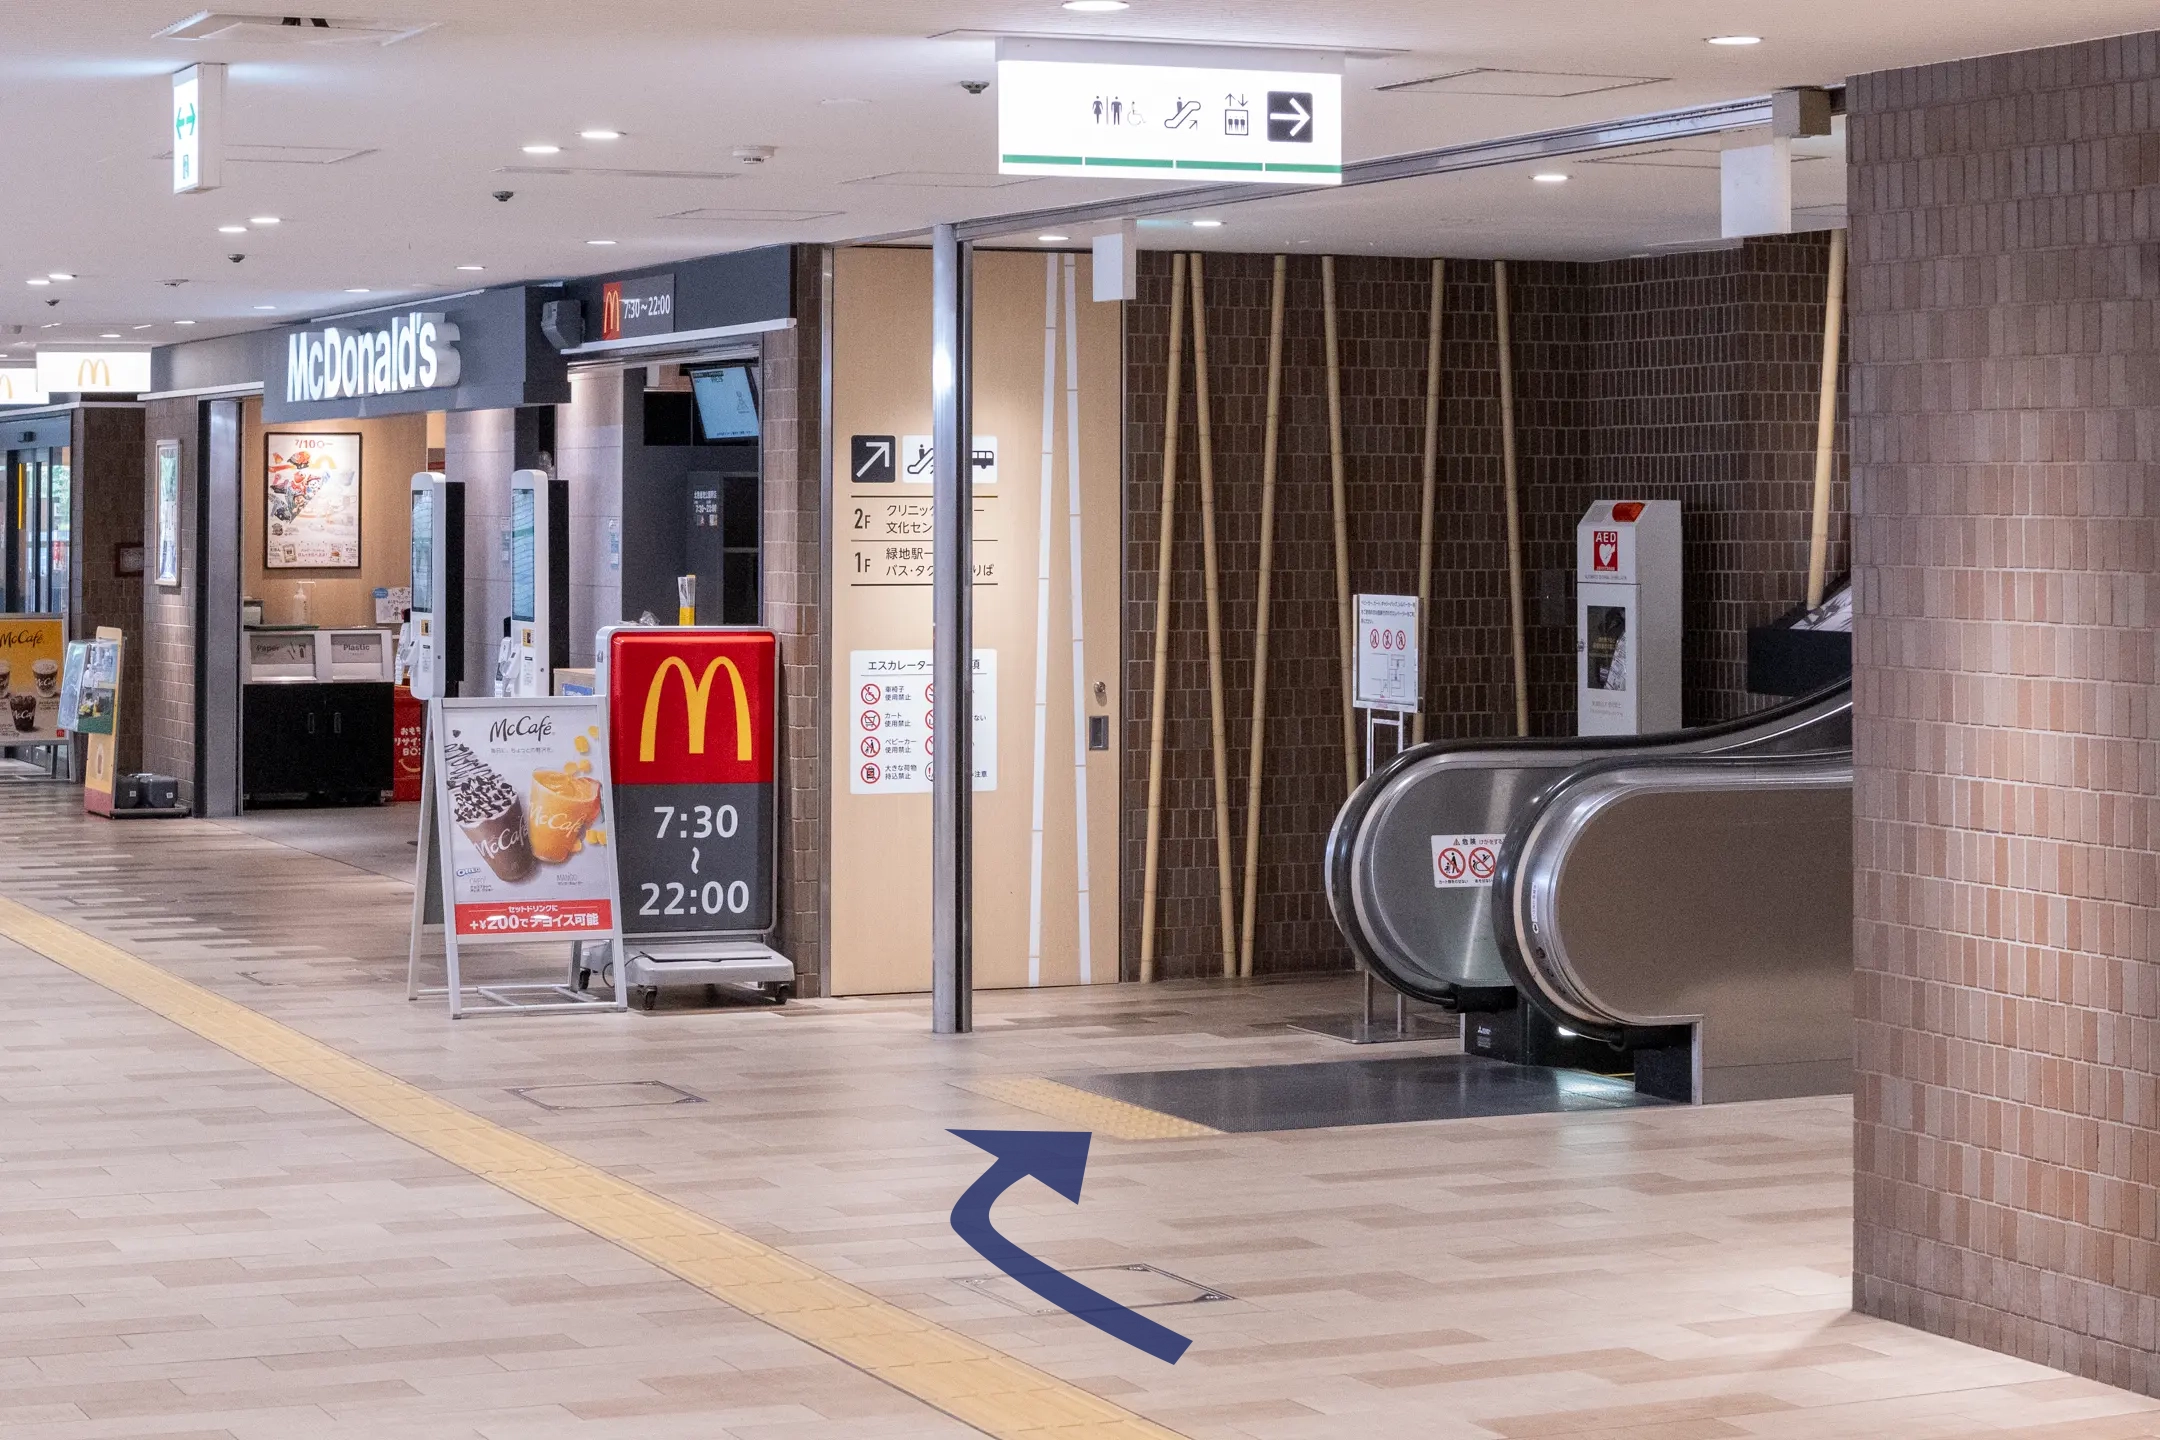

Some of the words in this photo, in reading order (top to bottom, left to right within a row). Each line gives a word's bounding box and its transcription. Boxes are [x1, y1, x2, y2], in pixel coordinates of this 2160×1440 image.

[286, 312, 438, 402] McDonald's
[854, 508, 871, 529] 2F
[1595, 532, 1617, 543] AED
[854, 552, 871, 573] 1F
[343, 643, 370, 652] Plastic
[489, 716, 553, 743] McCafé
[885, 746, 912, 754] 使用禁止
[653, 804, 739, 839] 7:30
[508, 904, 559, 913] セットドリンクに
[638, 880, 750, 916] 22:00
